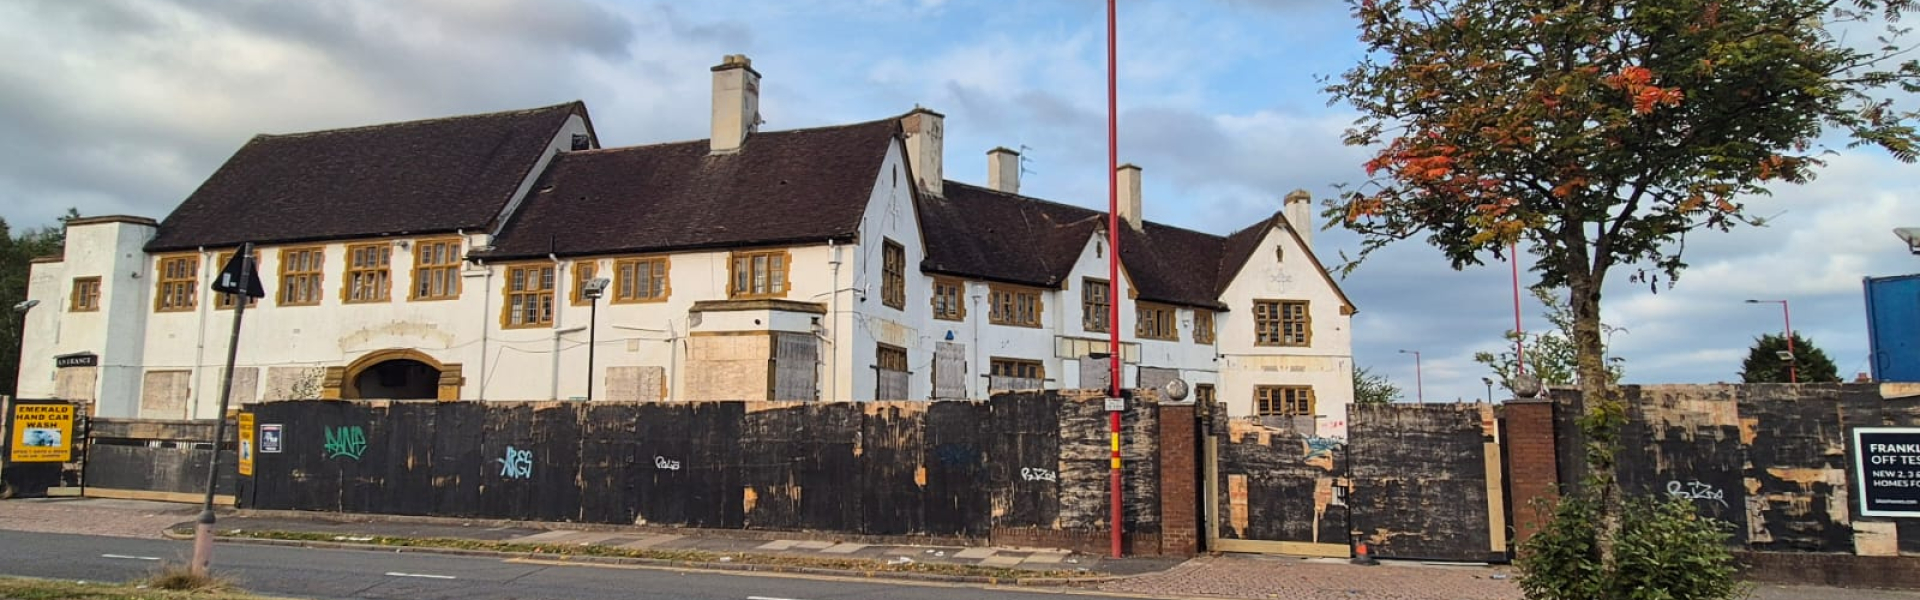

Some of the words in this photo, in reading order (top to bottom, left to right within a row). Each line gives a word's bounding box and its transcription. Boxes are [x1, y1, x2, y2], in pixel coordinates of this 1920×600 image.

[1870, 443, 1920, 453] FRANKL
[1871, 455, 1897, 465] OFF
[1872, 470, 1896, 478] NEW
[1873, 479, 1909, 487] HOMES
